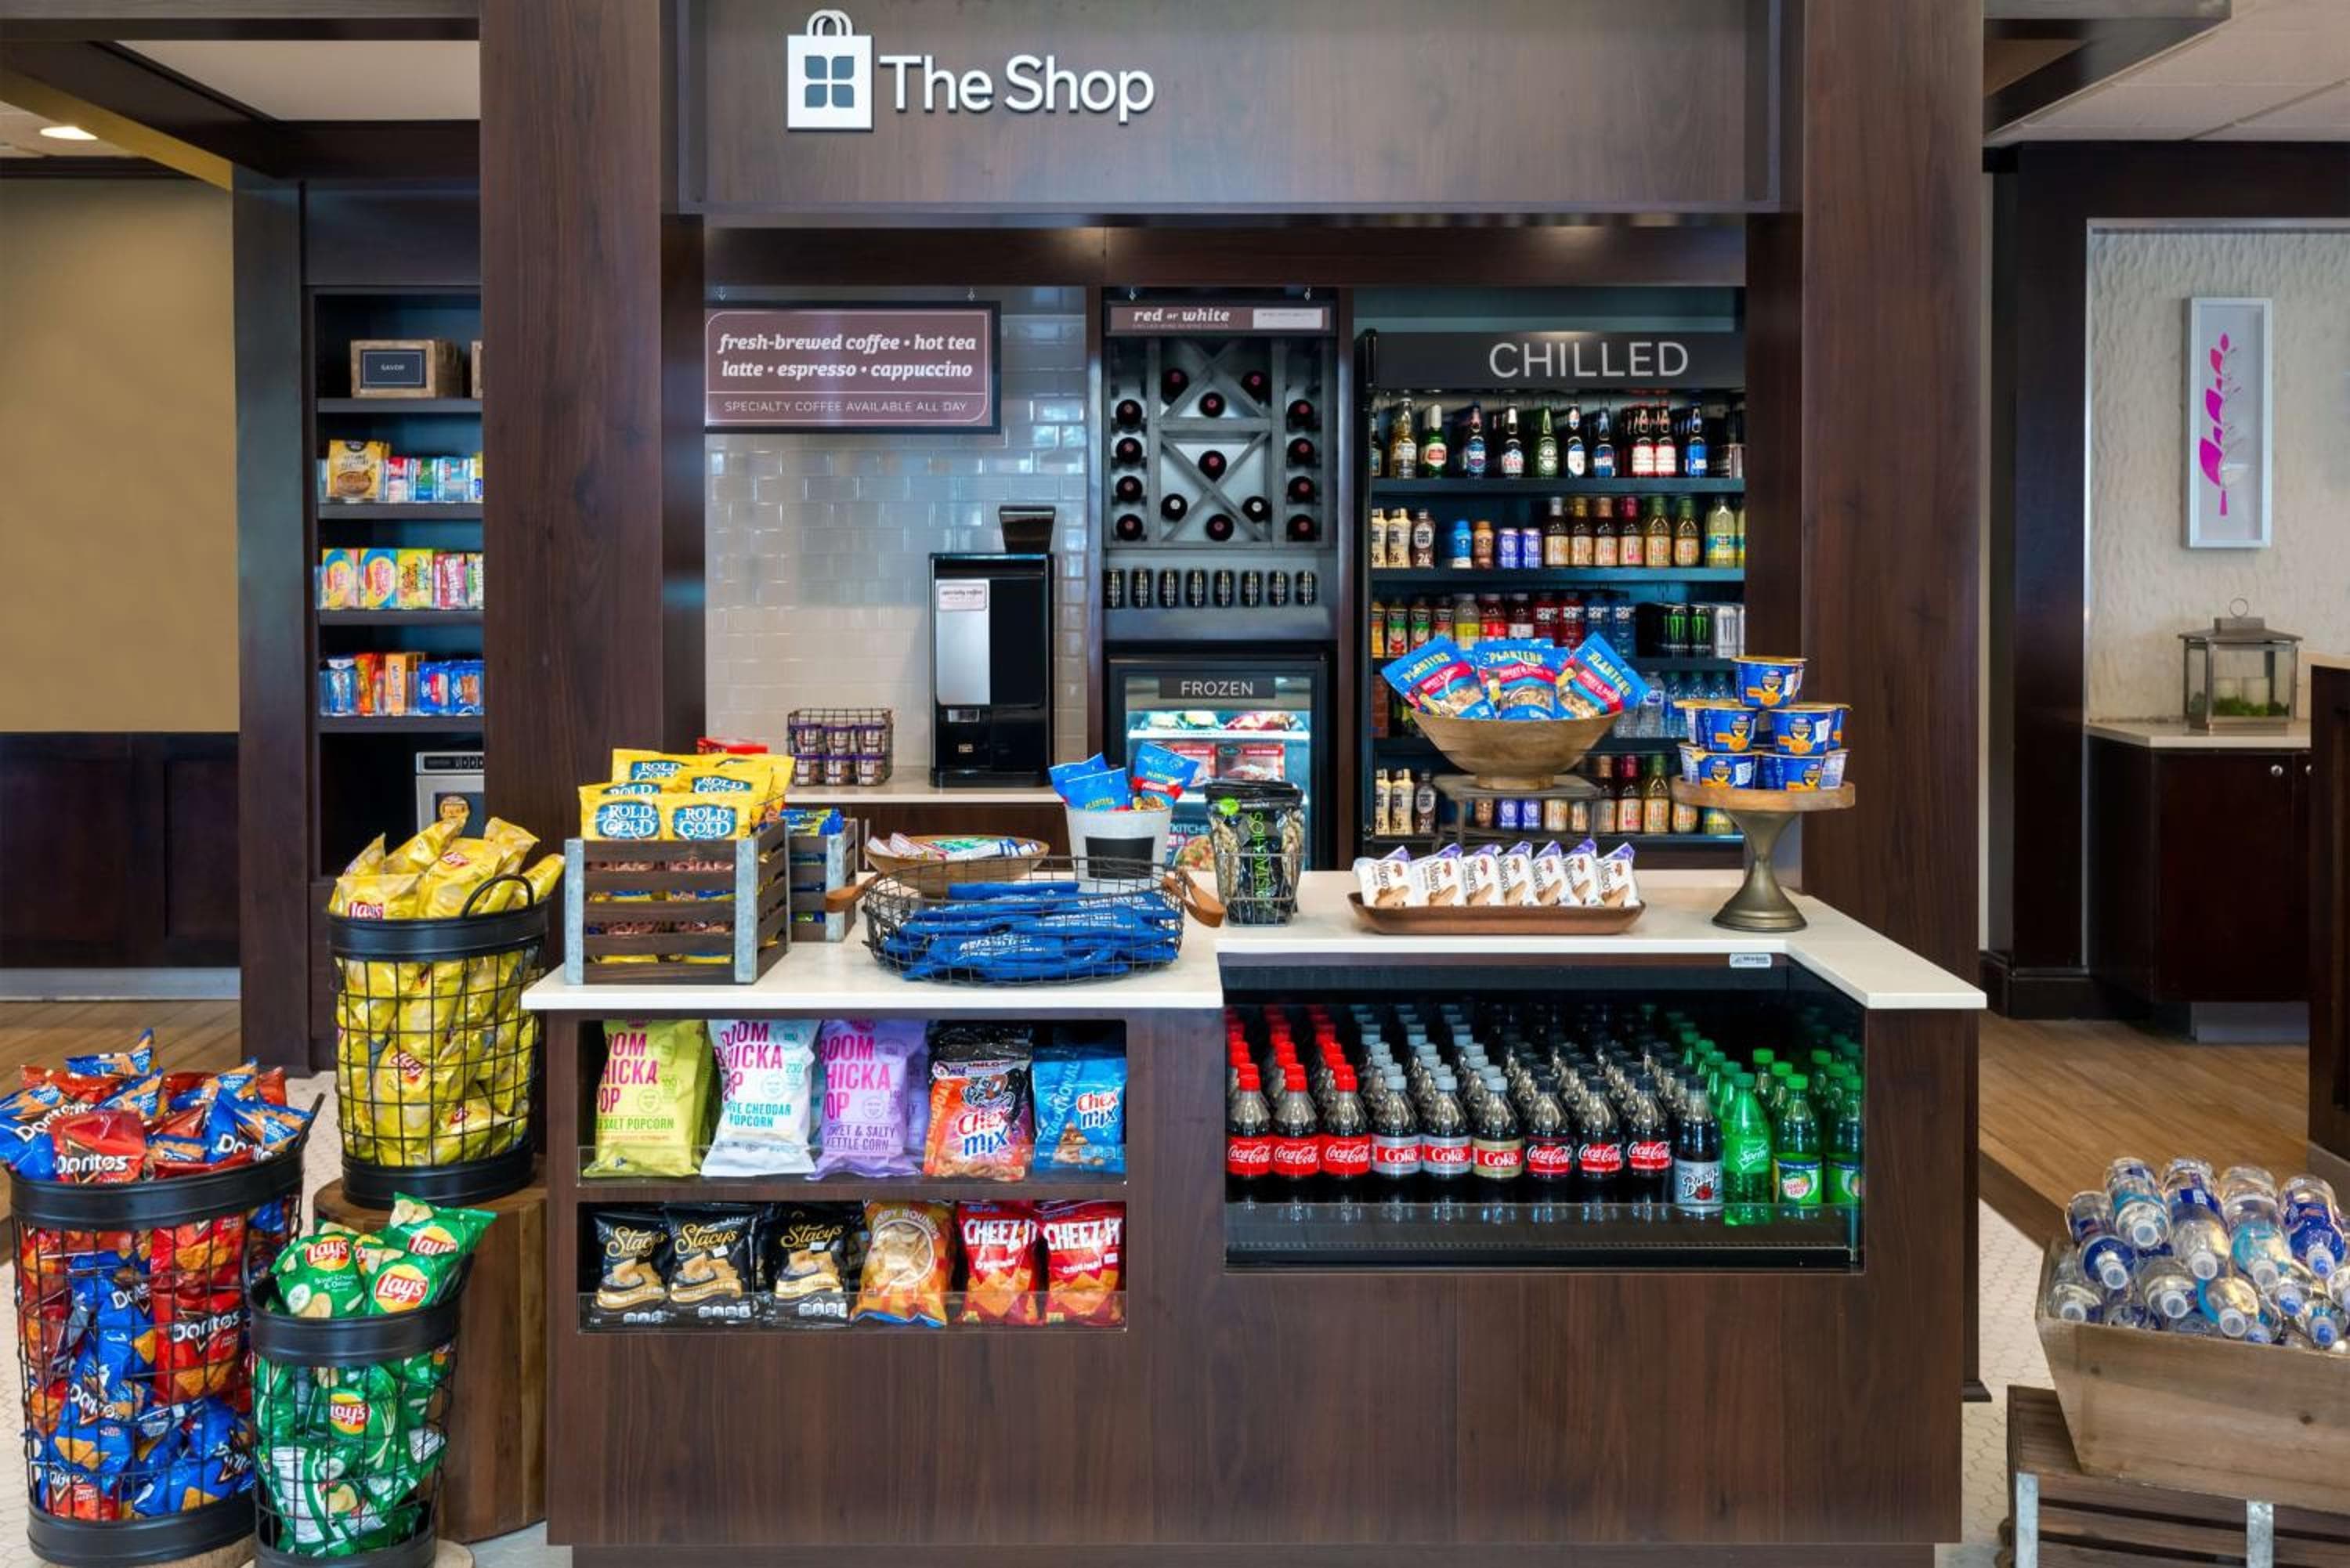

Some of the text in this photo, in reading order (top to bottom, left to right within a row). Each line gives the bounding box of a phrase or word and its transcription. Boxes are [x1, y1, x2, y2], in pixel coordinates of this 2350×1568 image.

[879, 55, 1155, 124] The Shop
[1133, 308, 1164, 322] red
[1182, 308, 1231, 322] white
[717, 334, 977, 355] fresh-brewed coffee hot tea
[1488, 341, 1689, 378] CHILLED
[721, 360, 974, 381] latte espresso cappuccino
[725, 401, 967, 412] SPECIALTY COFFEE AVAILABLE ALL DAY
[1180, 681, 1254, 696] FROZEN
[642, 762, 682, 772] ROLD
[609, 804, 653, 819] ROLD
[685, 807, 730, 822] ROLD
[602, 819, 655, 836] GOLD
[679, 822, 731, 836] GOLD
[826, 1064, 891, 1091] HICKA
[746, 1103, 792, 1116] CHEDDAR
[826, 1092, 851, 1121] OP
[627, 1118, 674, 1129] POPCORN
[957, 1108, 1009, 1135] Chex
[866, 1126, 896, 1138] SALTY
[862, 1138, 890, 1151] CORN
[1432, 1147, 1465, 1162] Coke
[1484, 1152, 1517, 1166] Coke
[56, 1154, 128, 1174] Doritos
[674, 1223, 738, 1253] Stacy's
[780, 1224, 844, 1248] Stacy's
[309, 1240, 348, 1264] Lay's
[378, 1273, 425, 1302] Lay's
[173, 1310, 240, 1343] Doritos
